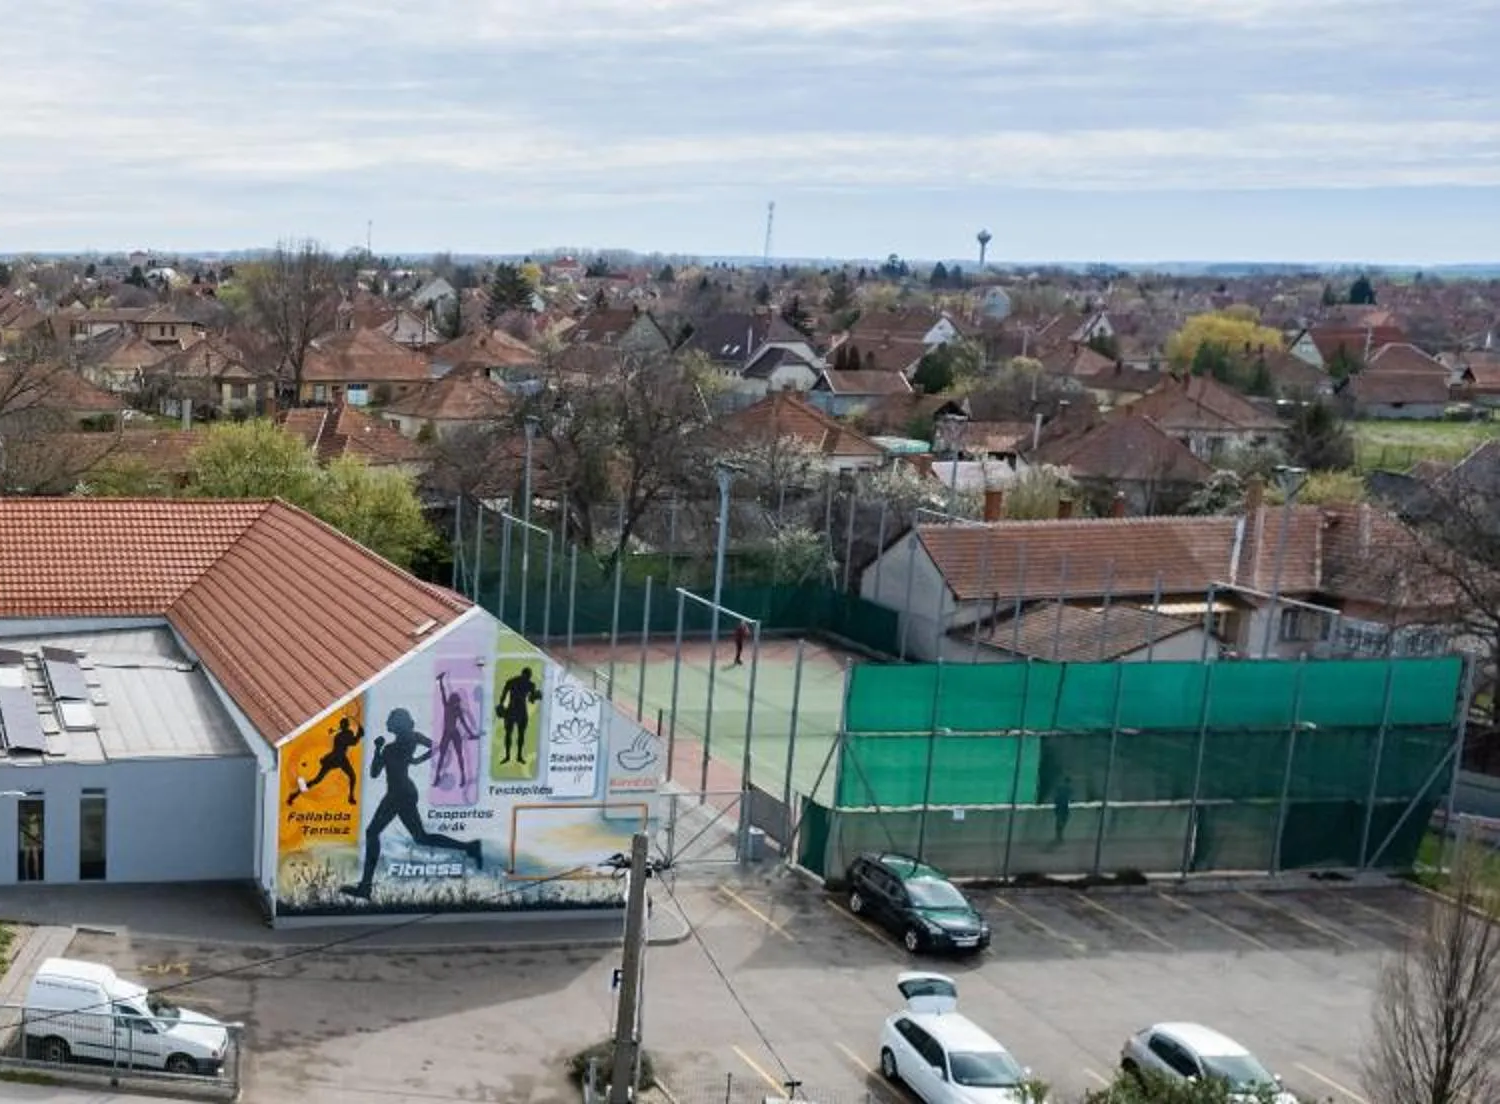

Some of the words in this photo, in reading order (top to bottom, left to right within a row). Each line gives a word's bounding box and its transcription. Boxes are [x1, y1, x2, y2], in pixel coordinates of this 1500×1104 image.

[287, 810, 351, 823] Fallabda
[427, 808, 494, 821] Csoportos
[301, 825, 351, 836] Tenisz
[387, 862, 463, 877] Fitness
